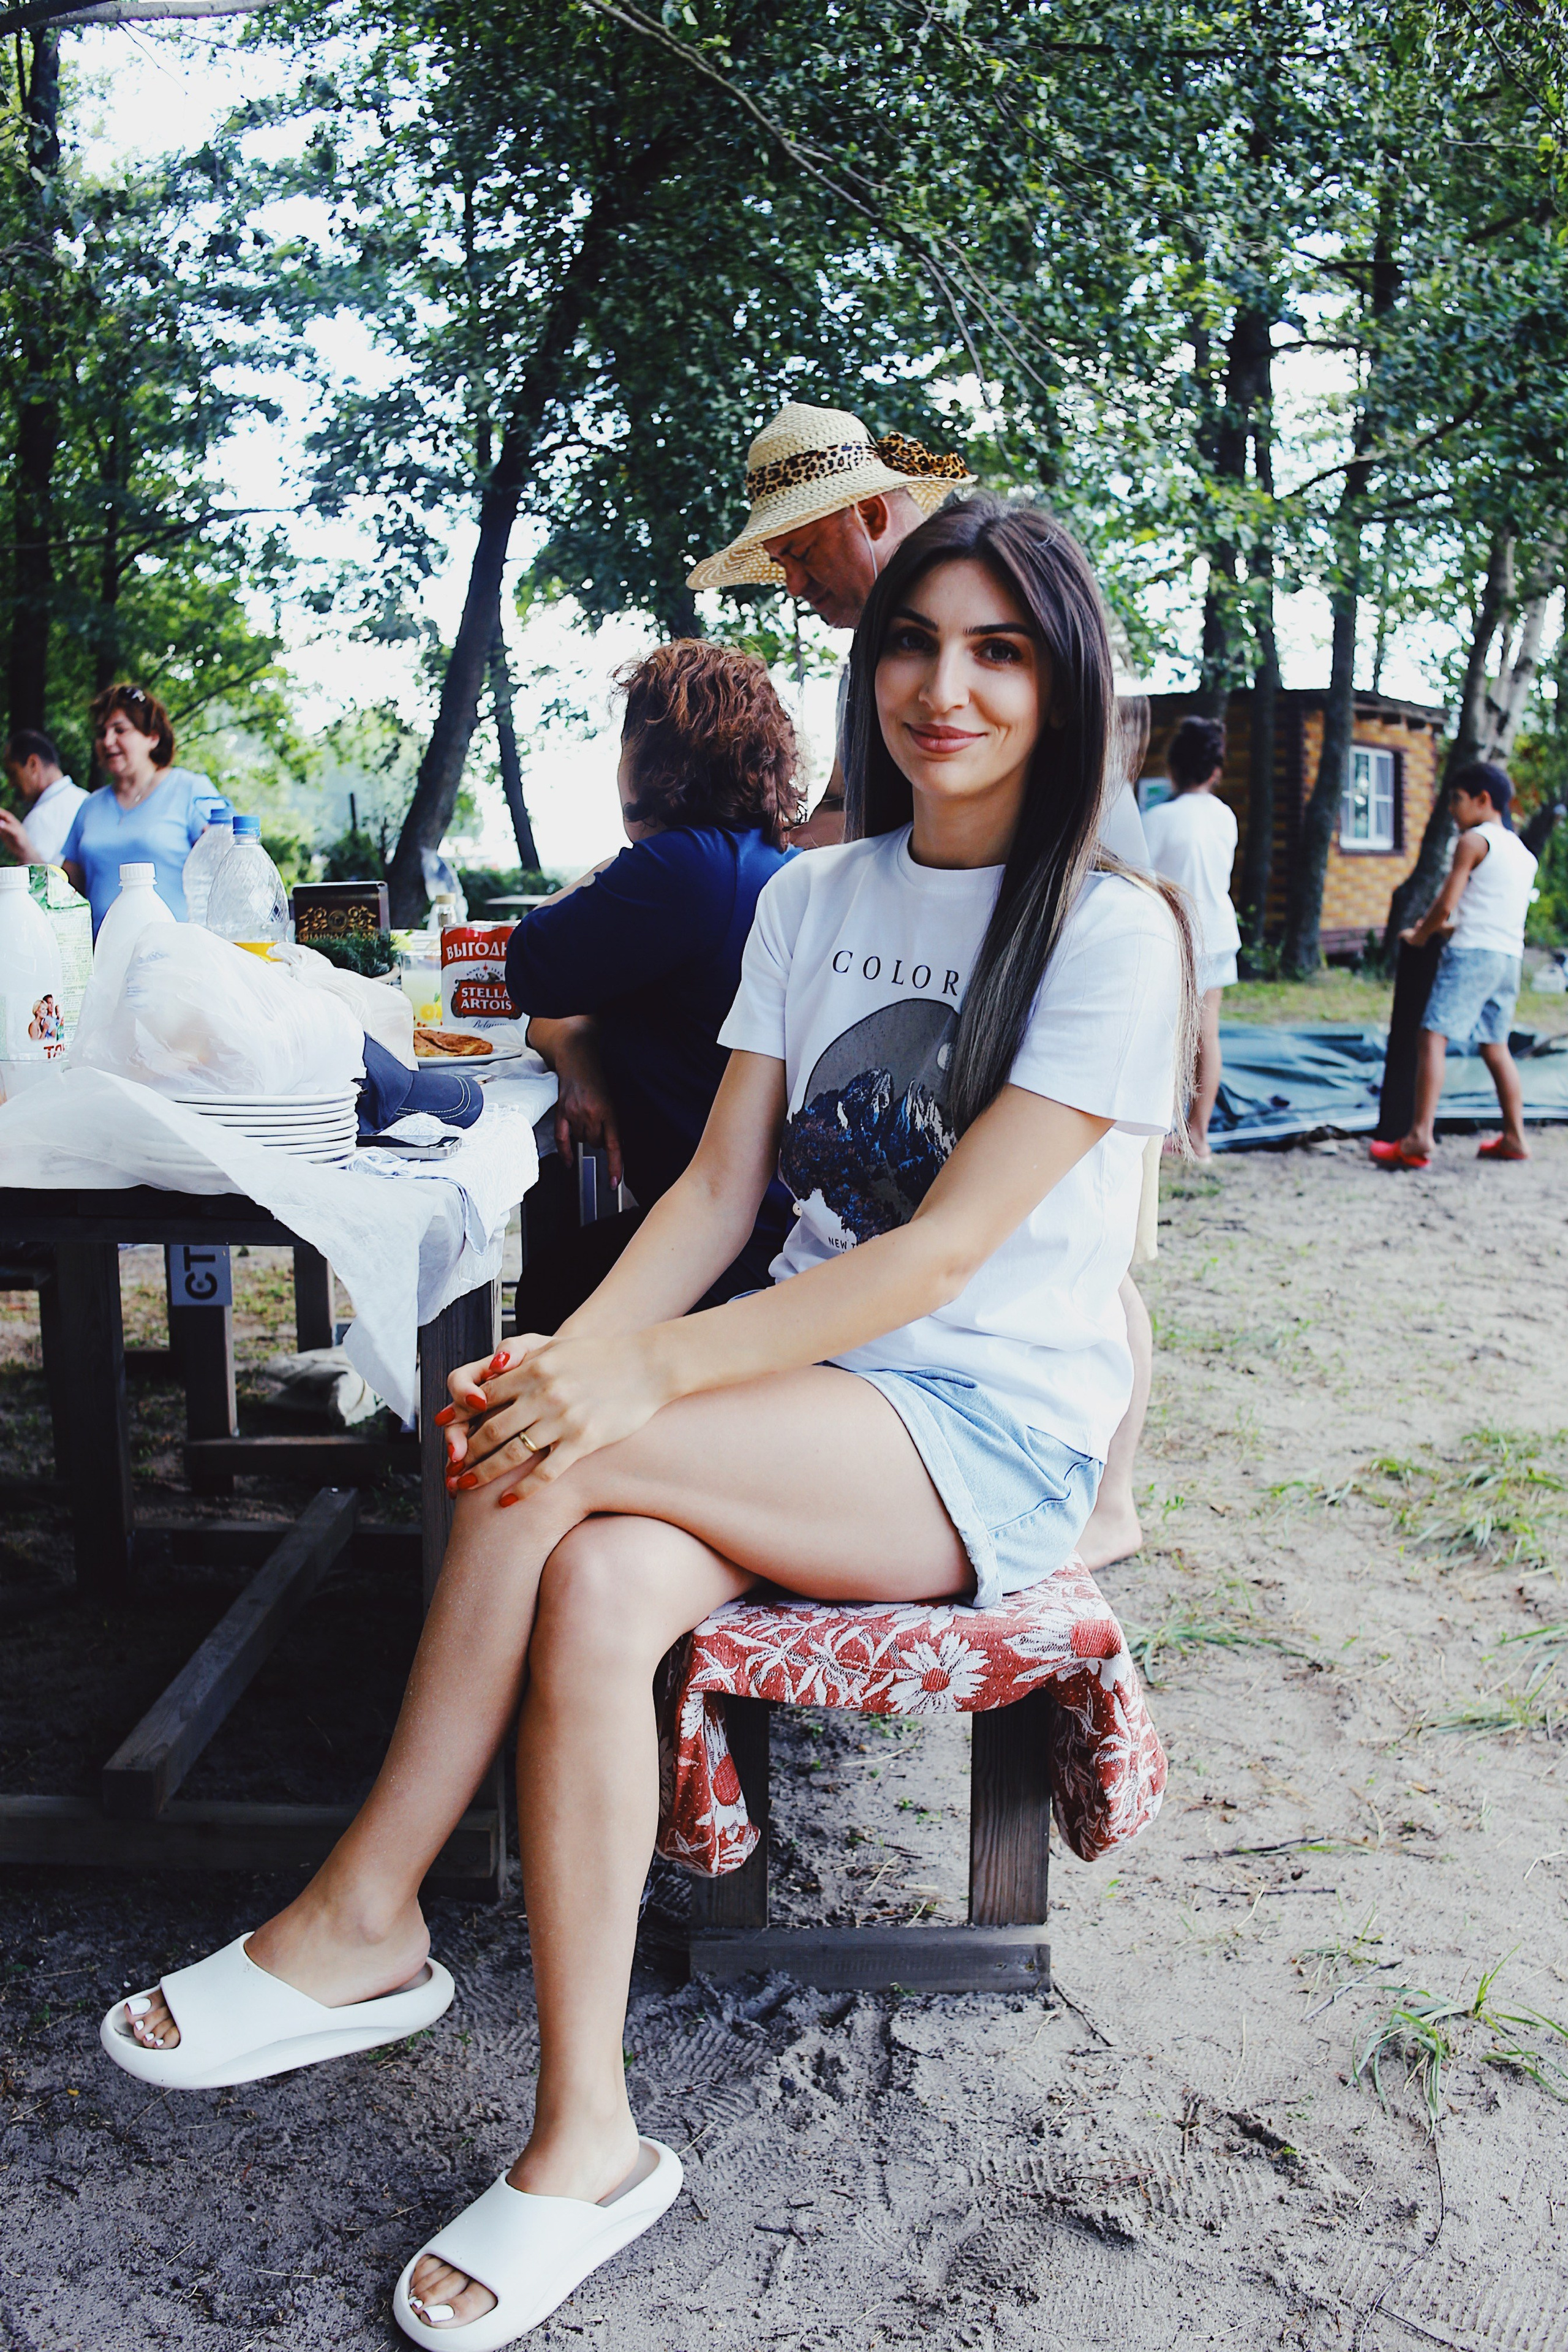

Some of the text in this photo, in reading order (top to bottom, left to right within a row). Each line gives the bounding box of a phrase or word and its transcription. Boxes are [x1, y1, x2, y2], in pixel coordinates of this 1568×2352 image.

[446, 941, 507, 961] ВЫГОДН
[832, 950, 959, 996] COLOR
[461, 987, 510, 999] STELLA
[461, 998, 512, 1011] ARTOIS
[43, 1044, 65, 1059] ТА
[828, 1237, 847, 1250] NEW
